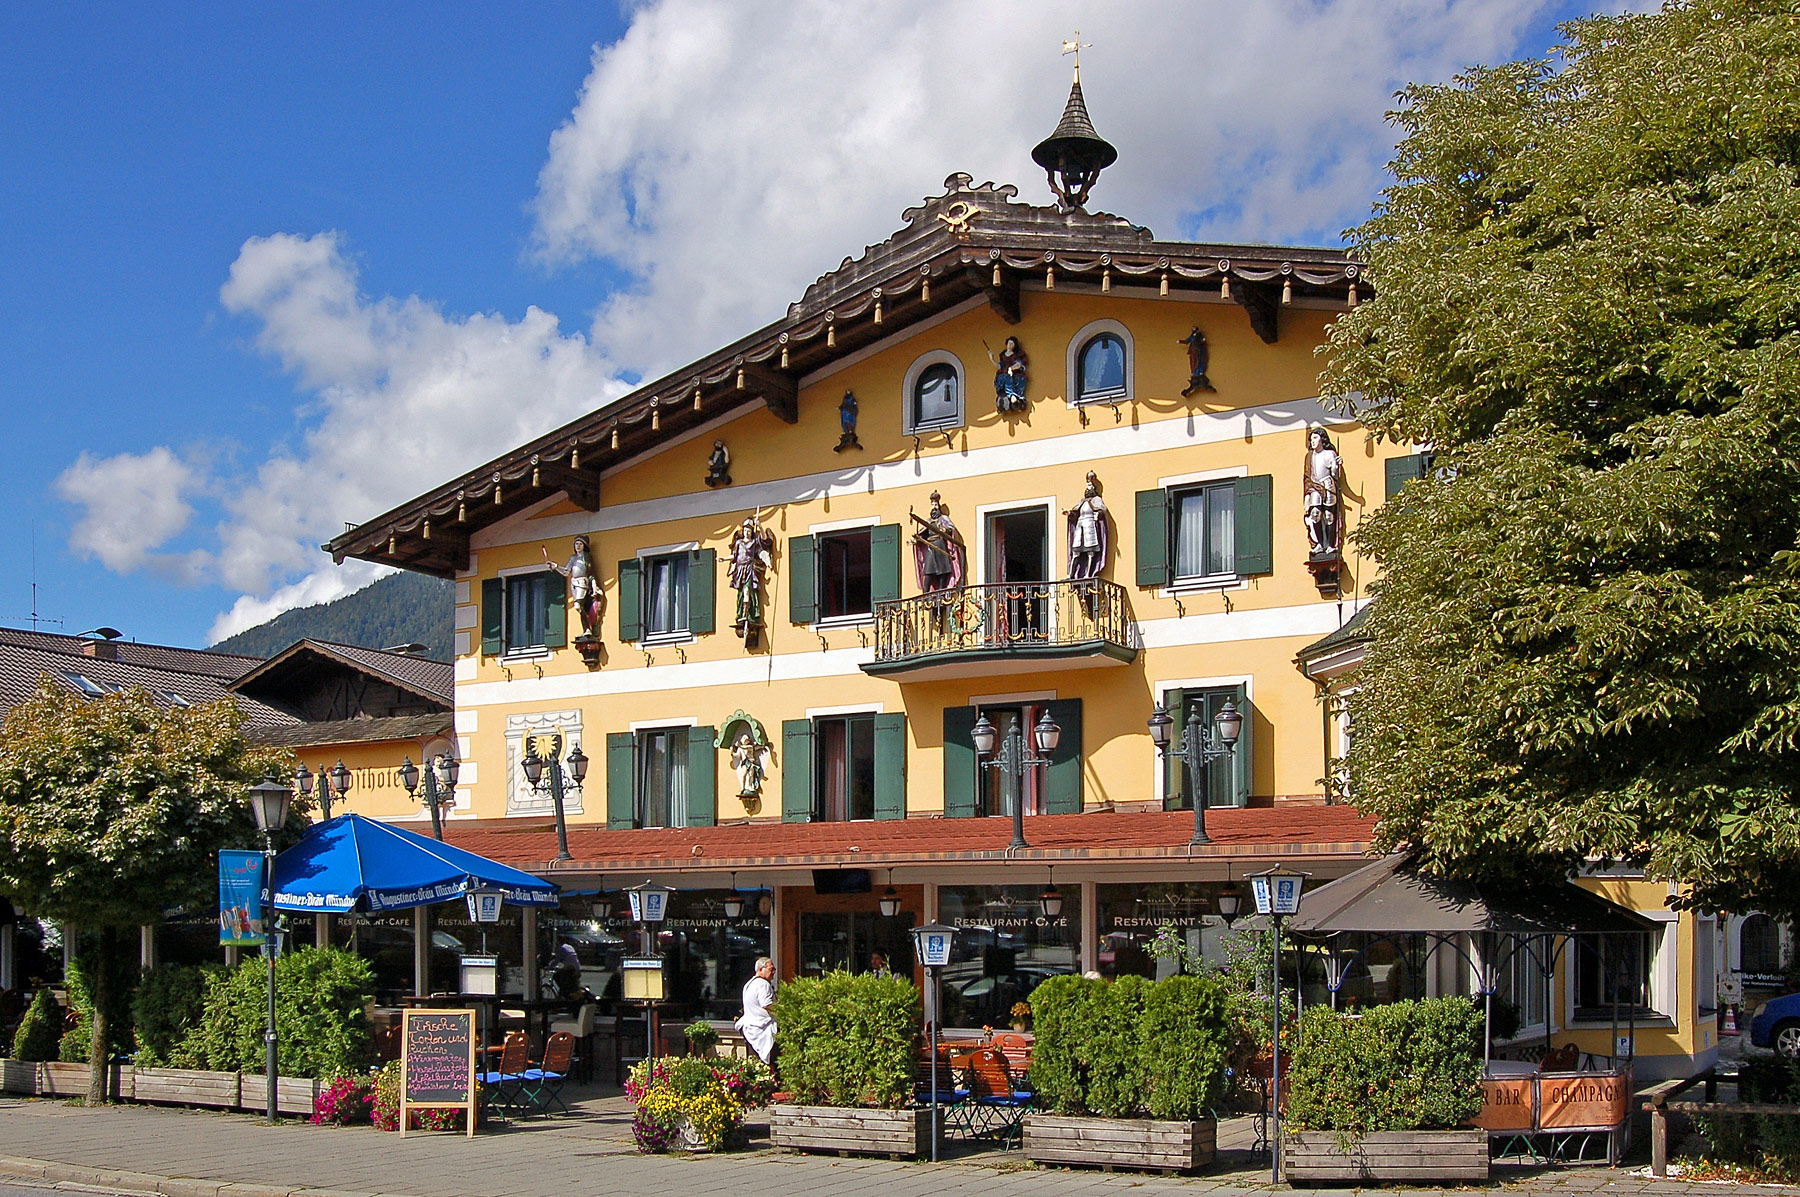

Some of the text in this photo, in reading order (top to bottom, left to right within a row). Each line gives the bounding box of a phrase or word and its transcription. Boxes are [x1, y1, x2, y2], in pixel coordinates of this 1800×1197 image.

[666, 918, 727, 927] RESTAURANT
[954, 917, 1028, 927] RESTAURANT
[409, 1031, 468, 1044] Torten und
[1620, 1038, 1627, 1046] P
[409, 1042, 447, 1054] Kuchen
[1495, 1088, 1520, 1106] BAR
